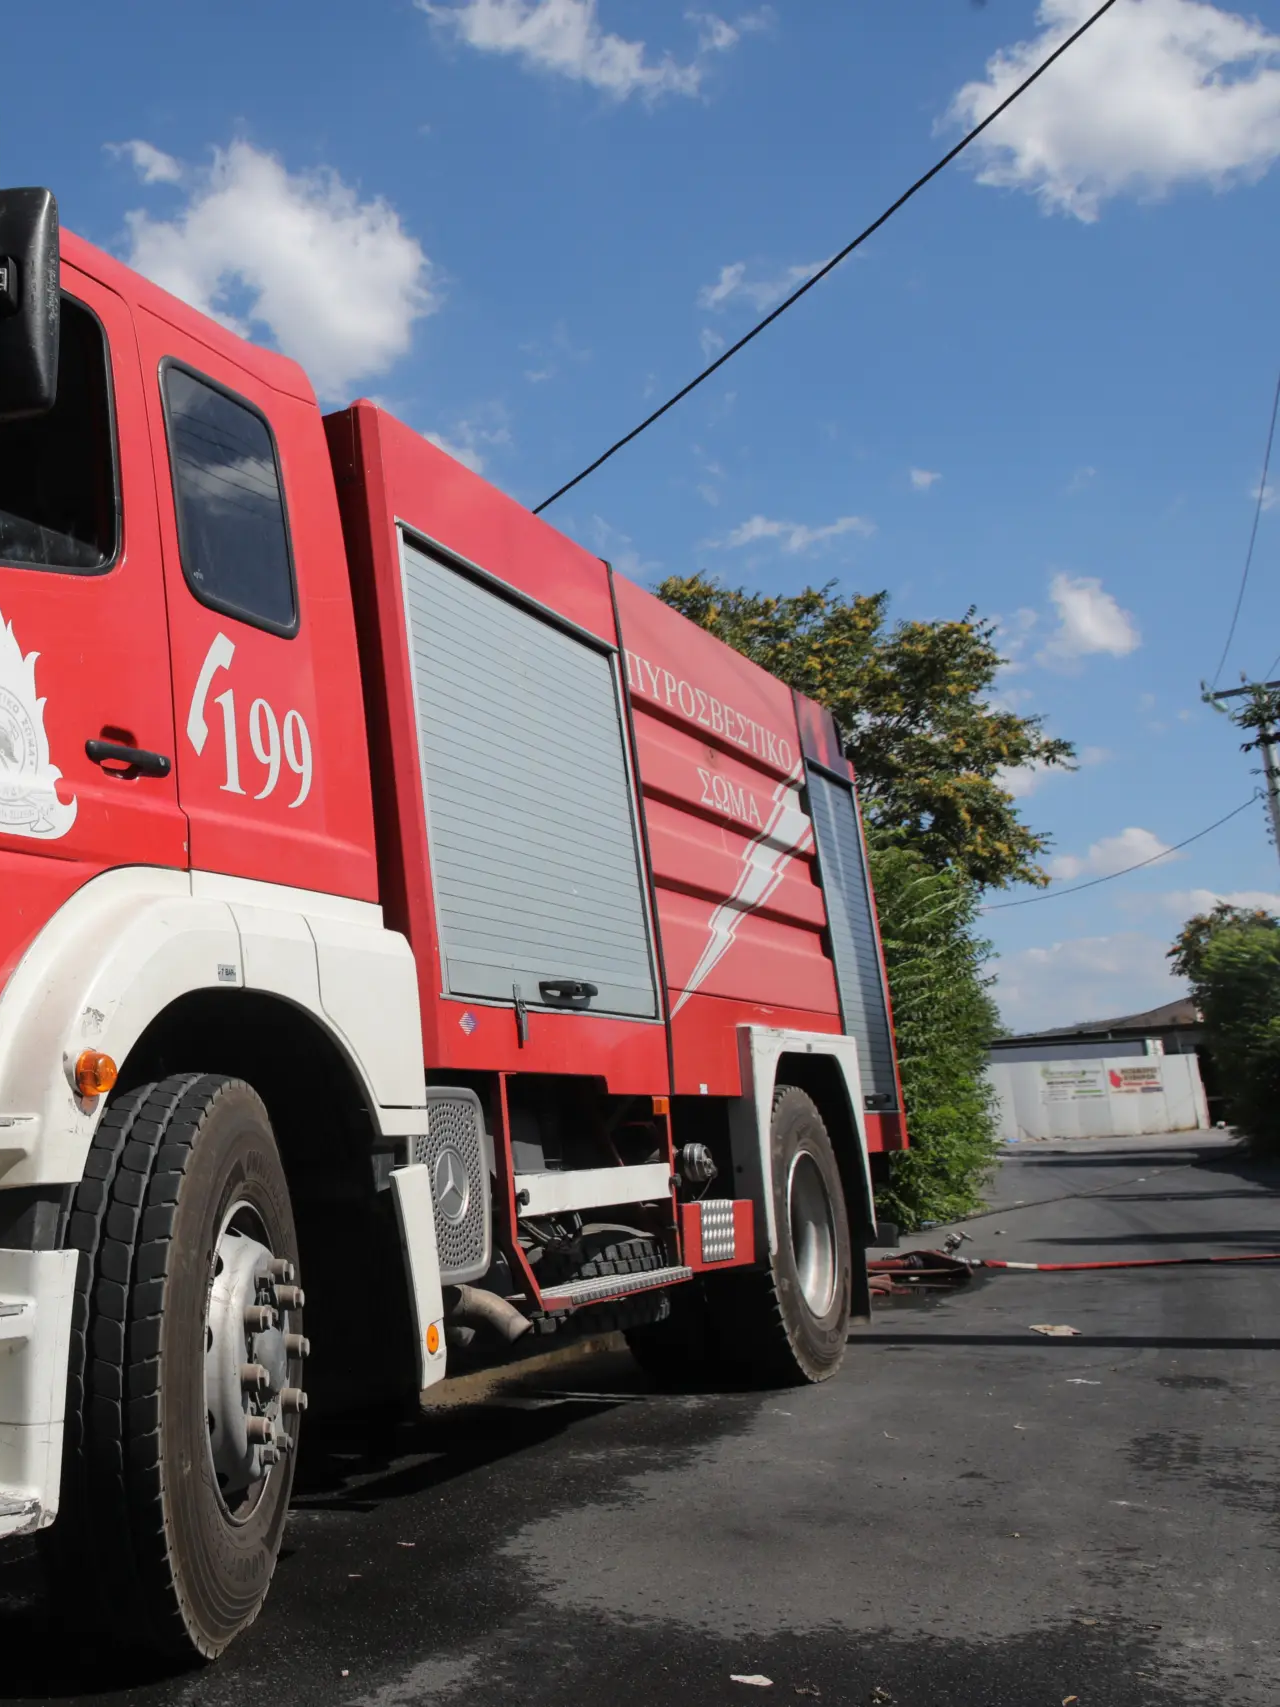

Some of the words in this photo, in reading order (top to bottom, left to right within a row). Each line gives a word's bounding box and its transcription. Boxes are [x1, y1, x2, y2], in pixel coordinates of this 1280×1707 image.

[214, 689, 313, 809] 199
[624, 648, 793, 772] ΠΥΡΟΣΒΕΣΤΙΚΟ
[695, 766, 764, 829] ΣΩΜΑ
